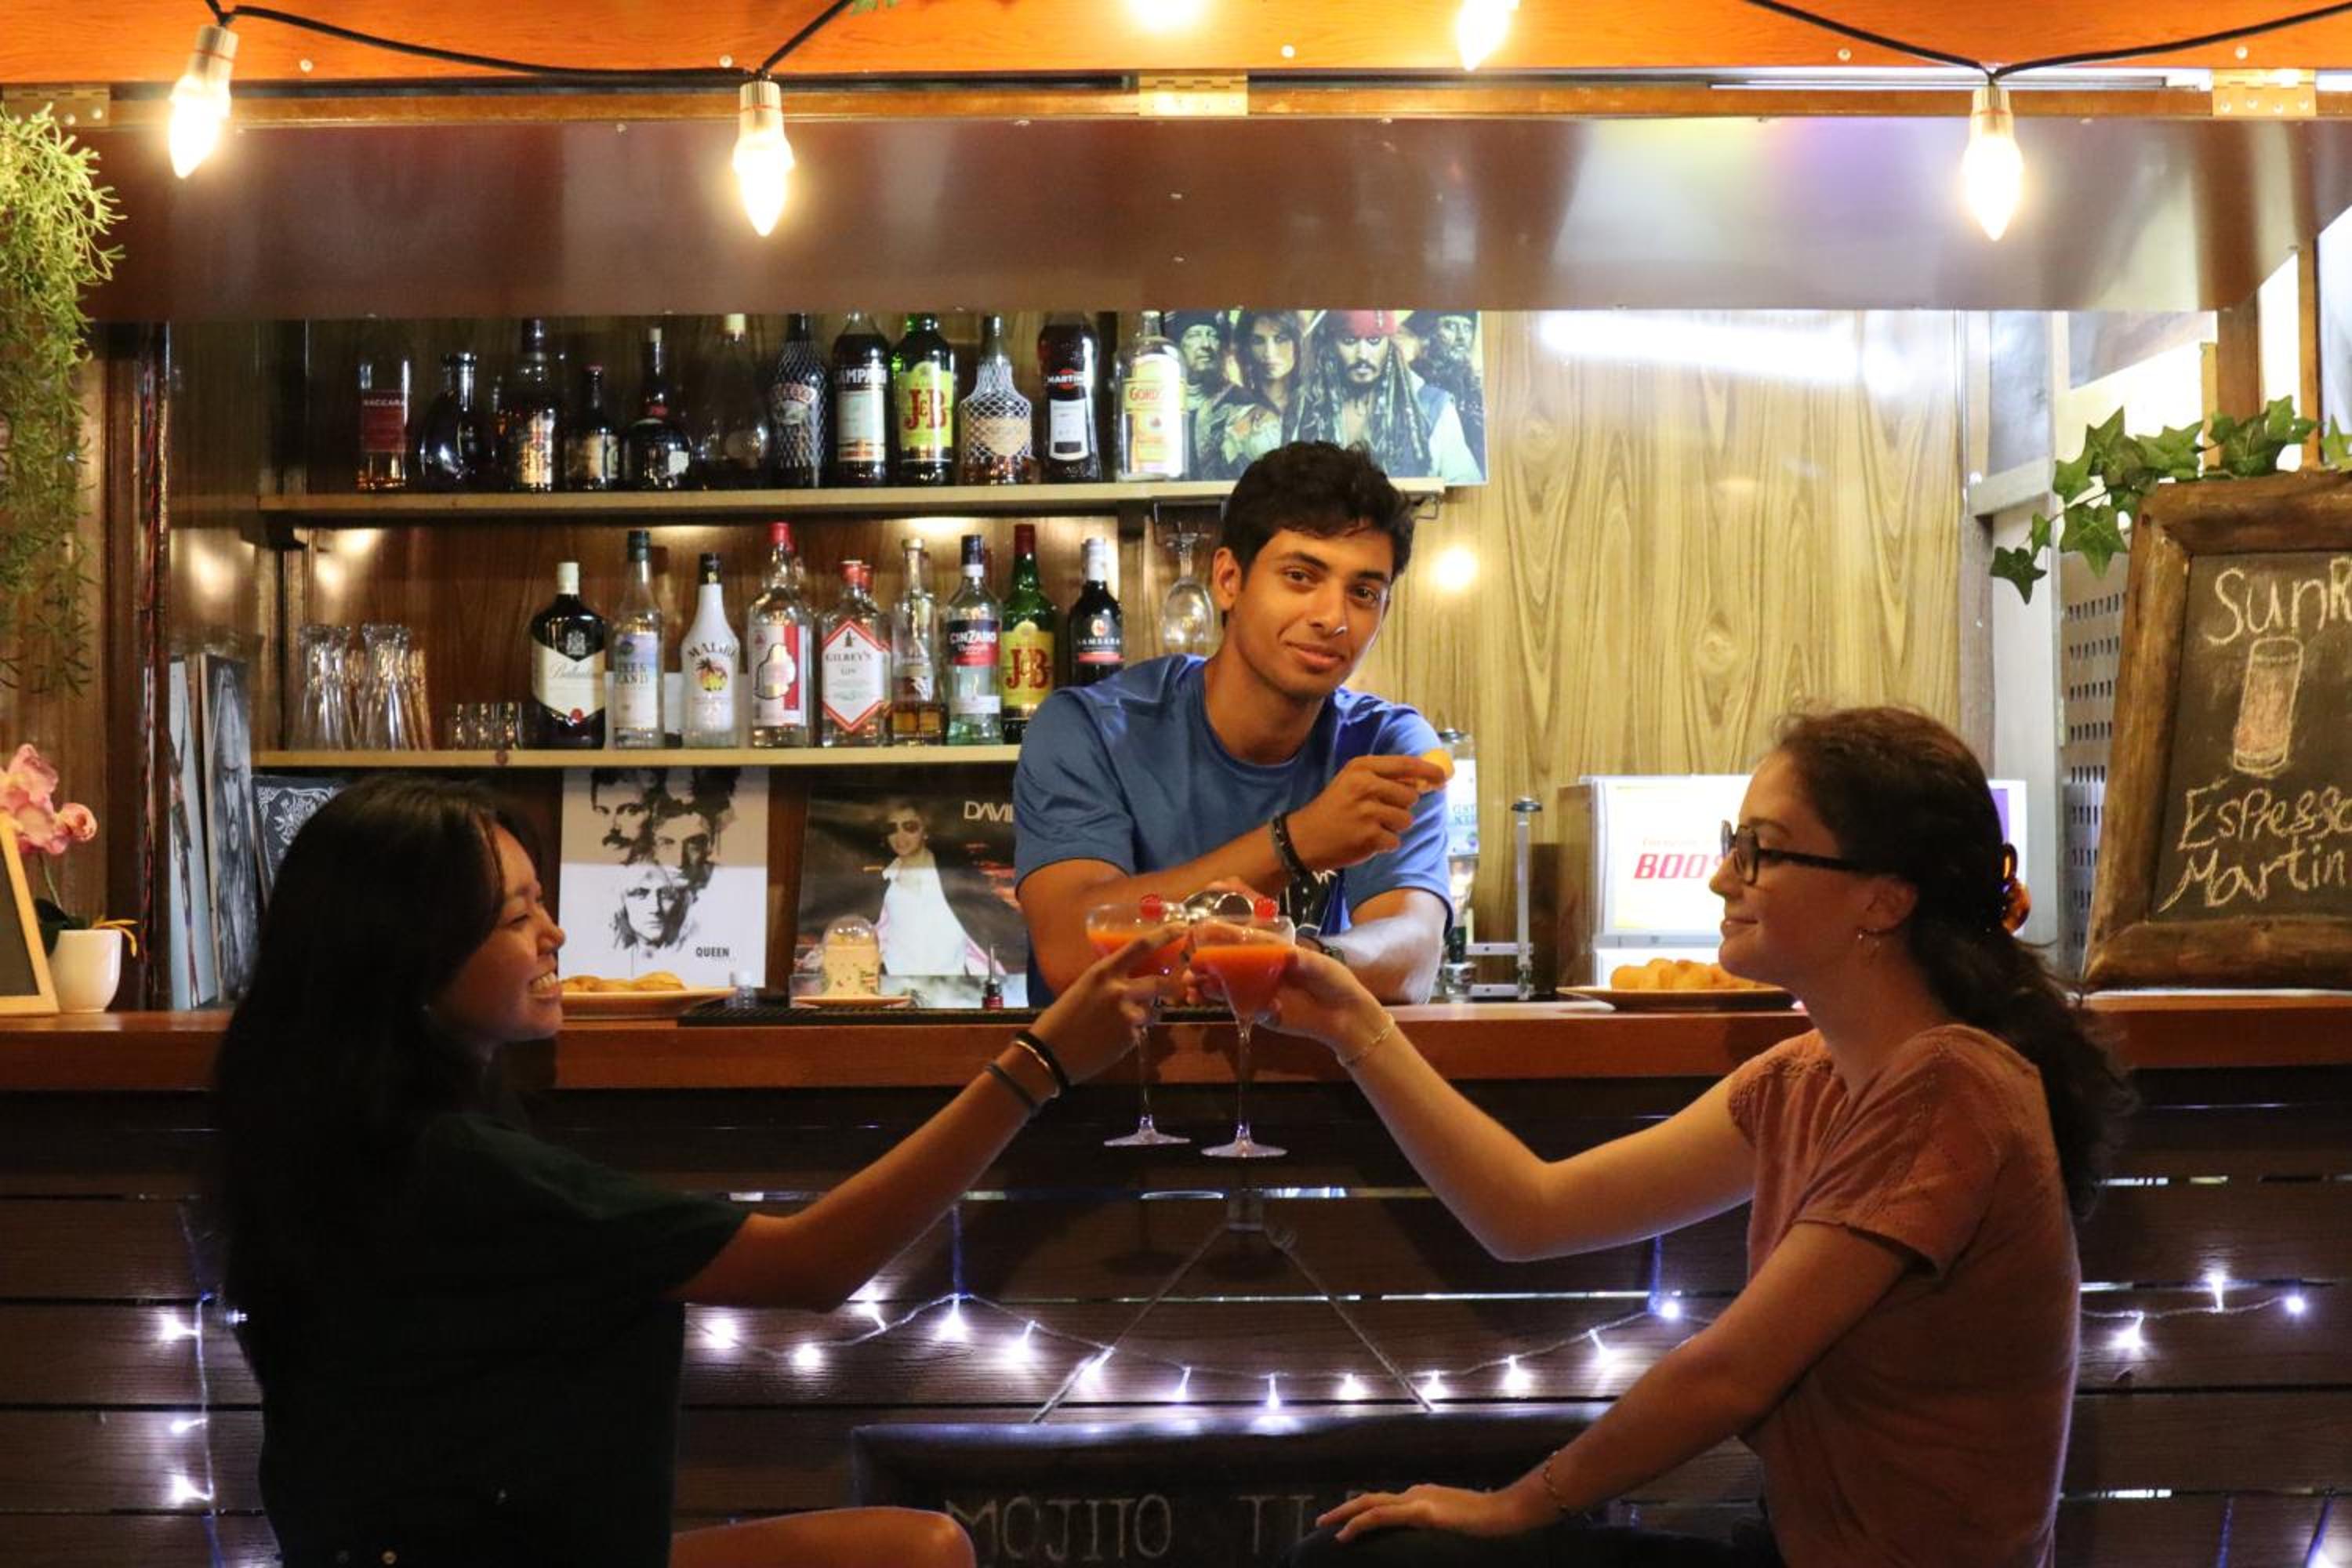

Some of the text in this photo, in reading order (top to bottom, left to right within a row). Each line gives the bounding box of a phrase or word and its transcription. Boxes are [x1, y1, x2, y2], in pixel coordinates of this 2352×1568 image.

[1047, 375, 1086, 383] MARTIN
[1005, 648, 1049, 689] J&B
[1633, 852, 1722, 879] BOO
[695, 946, 730, 957] QUEEN
